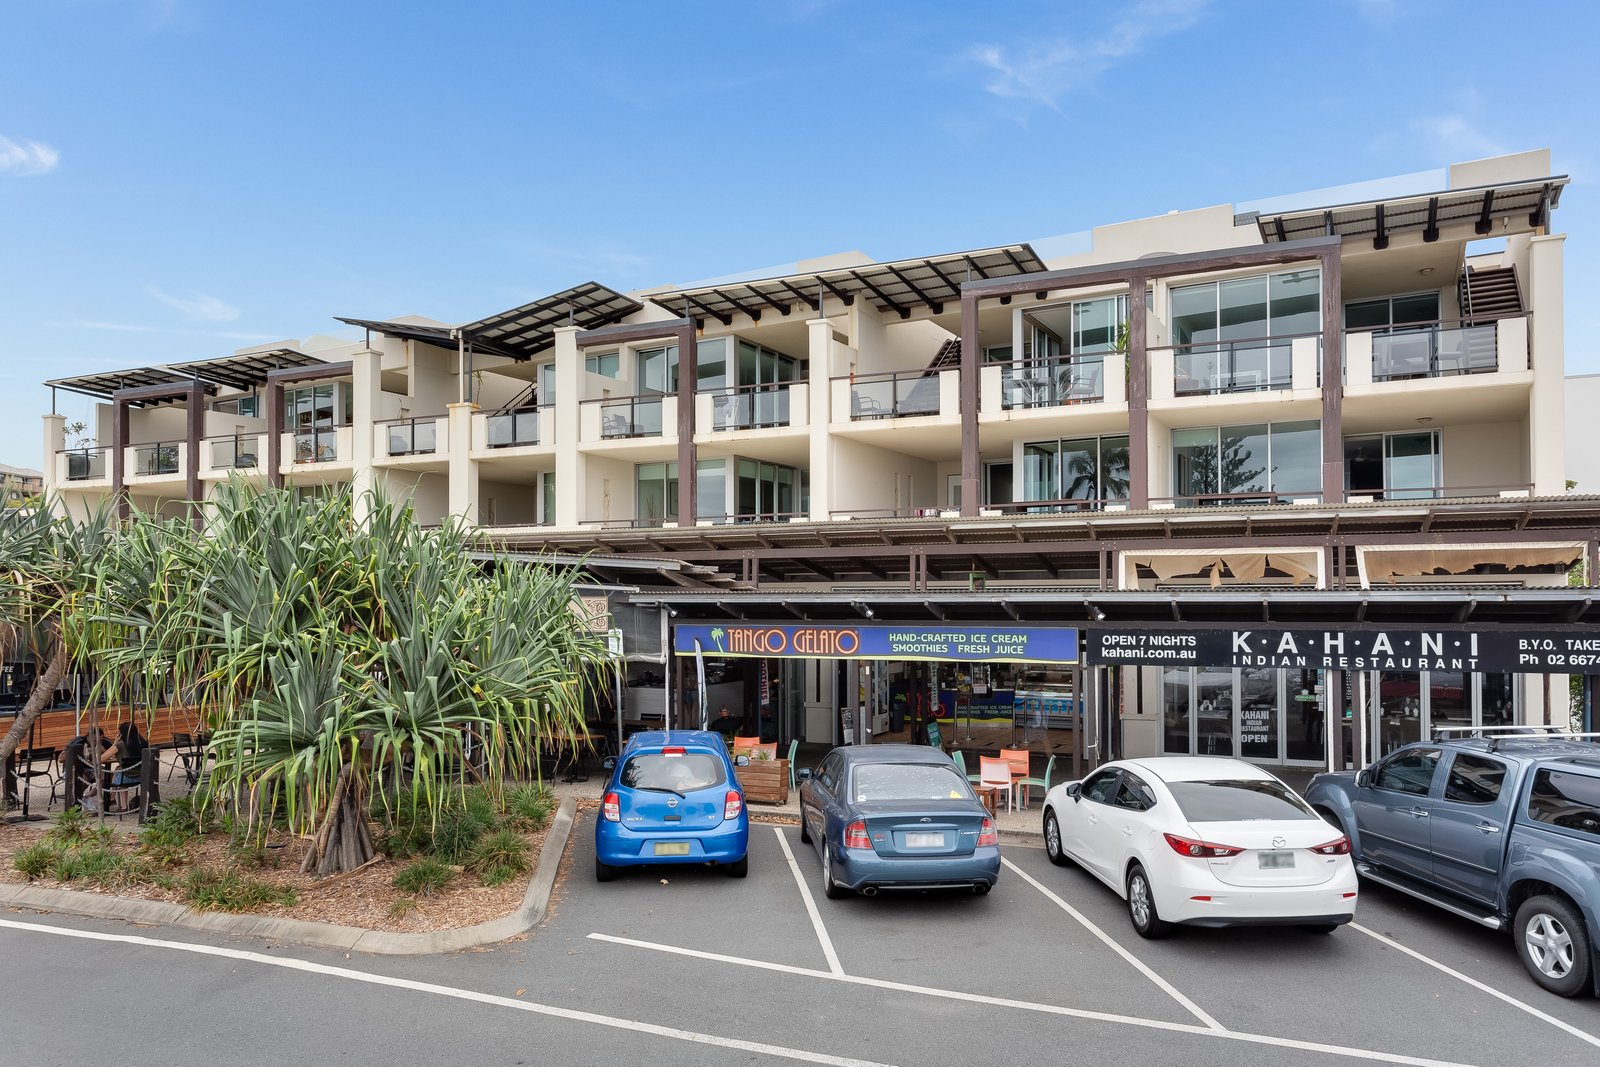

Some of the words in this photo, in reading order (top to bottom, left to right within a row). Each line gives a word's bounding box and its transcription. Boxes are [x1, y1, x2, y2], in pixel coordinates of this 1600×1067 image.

[727, 629, 787, 653] TANGO
[793, 629, 859, 654] GELATO
[889, 633, 967, 643] HAND-CRAFTED
[971, 634, 987, 643] ICE
[991, 634, 1027, 643] CREAM
[1102, 635, 1136, 645] OPEN
[1139, 635, 1146, 645] 7
[1149, 635, 1197, 646] NIGHTS
[892, 643, 948, 653] SMOOTHIES
[958, 645, 990, 653] FRESH
[994, 645, 1024, 654] JUICE
[1519, 639, 1557, 650] B.Y.O.
[1565, 639, 1600, 651] TAKE
[1101, 647, 1197, 658] kahani.com.au
[1232, 655, 1306, 666] INDIAN
[1323, 656, 1478, 669] RESTAURANT
[1519, 653, 1539, 665] Ph
[1547, 654, 1565, 665] 02
[1241, 734, 1268, 743] OPEN
